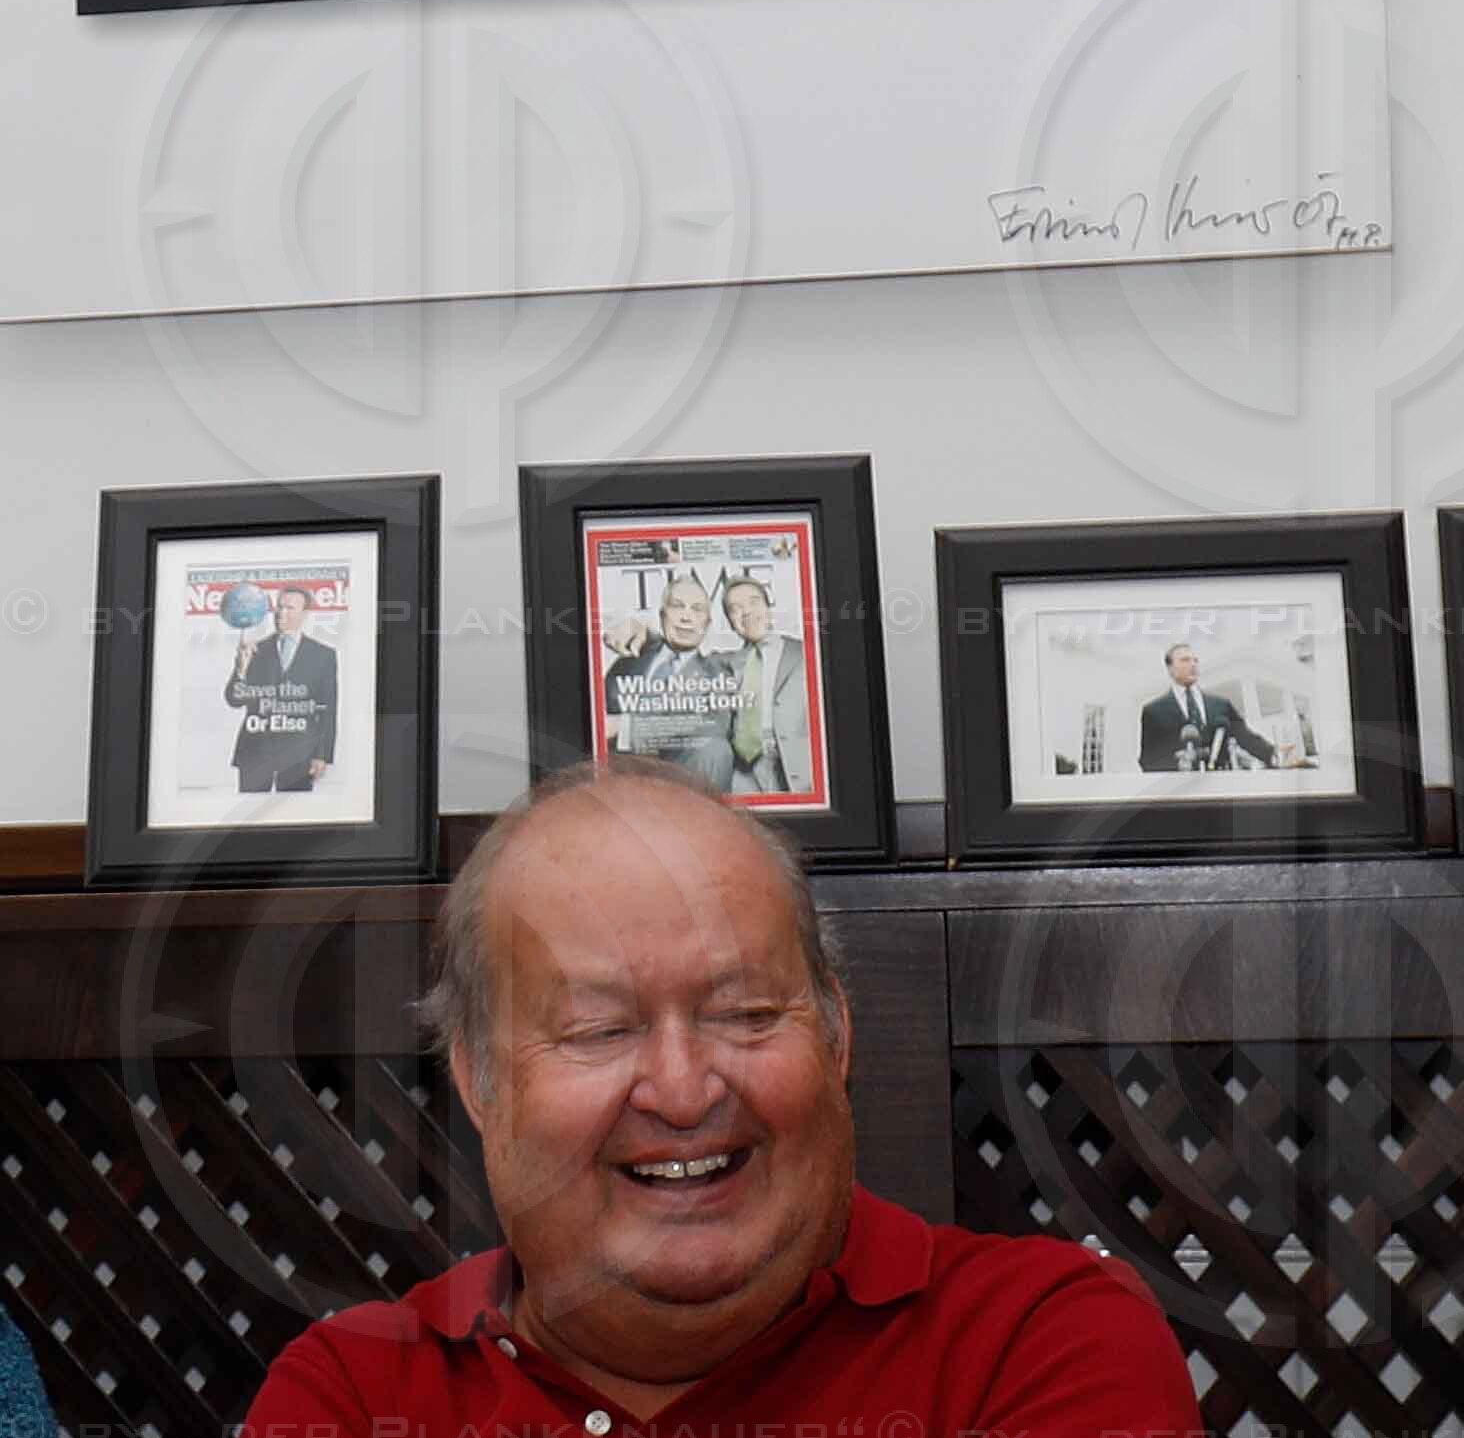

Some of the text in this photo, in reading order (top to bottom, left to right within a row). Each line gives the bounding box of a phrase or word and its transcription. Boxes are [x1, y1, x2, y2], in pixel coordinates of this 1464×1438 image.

[233, 682, 276, 698] Save
[616, 673, 737, 694] Who Needs
[617, 691, 756, 713] Washington?
